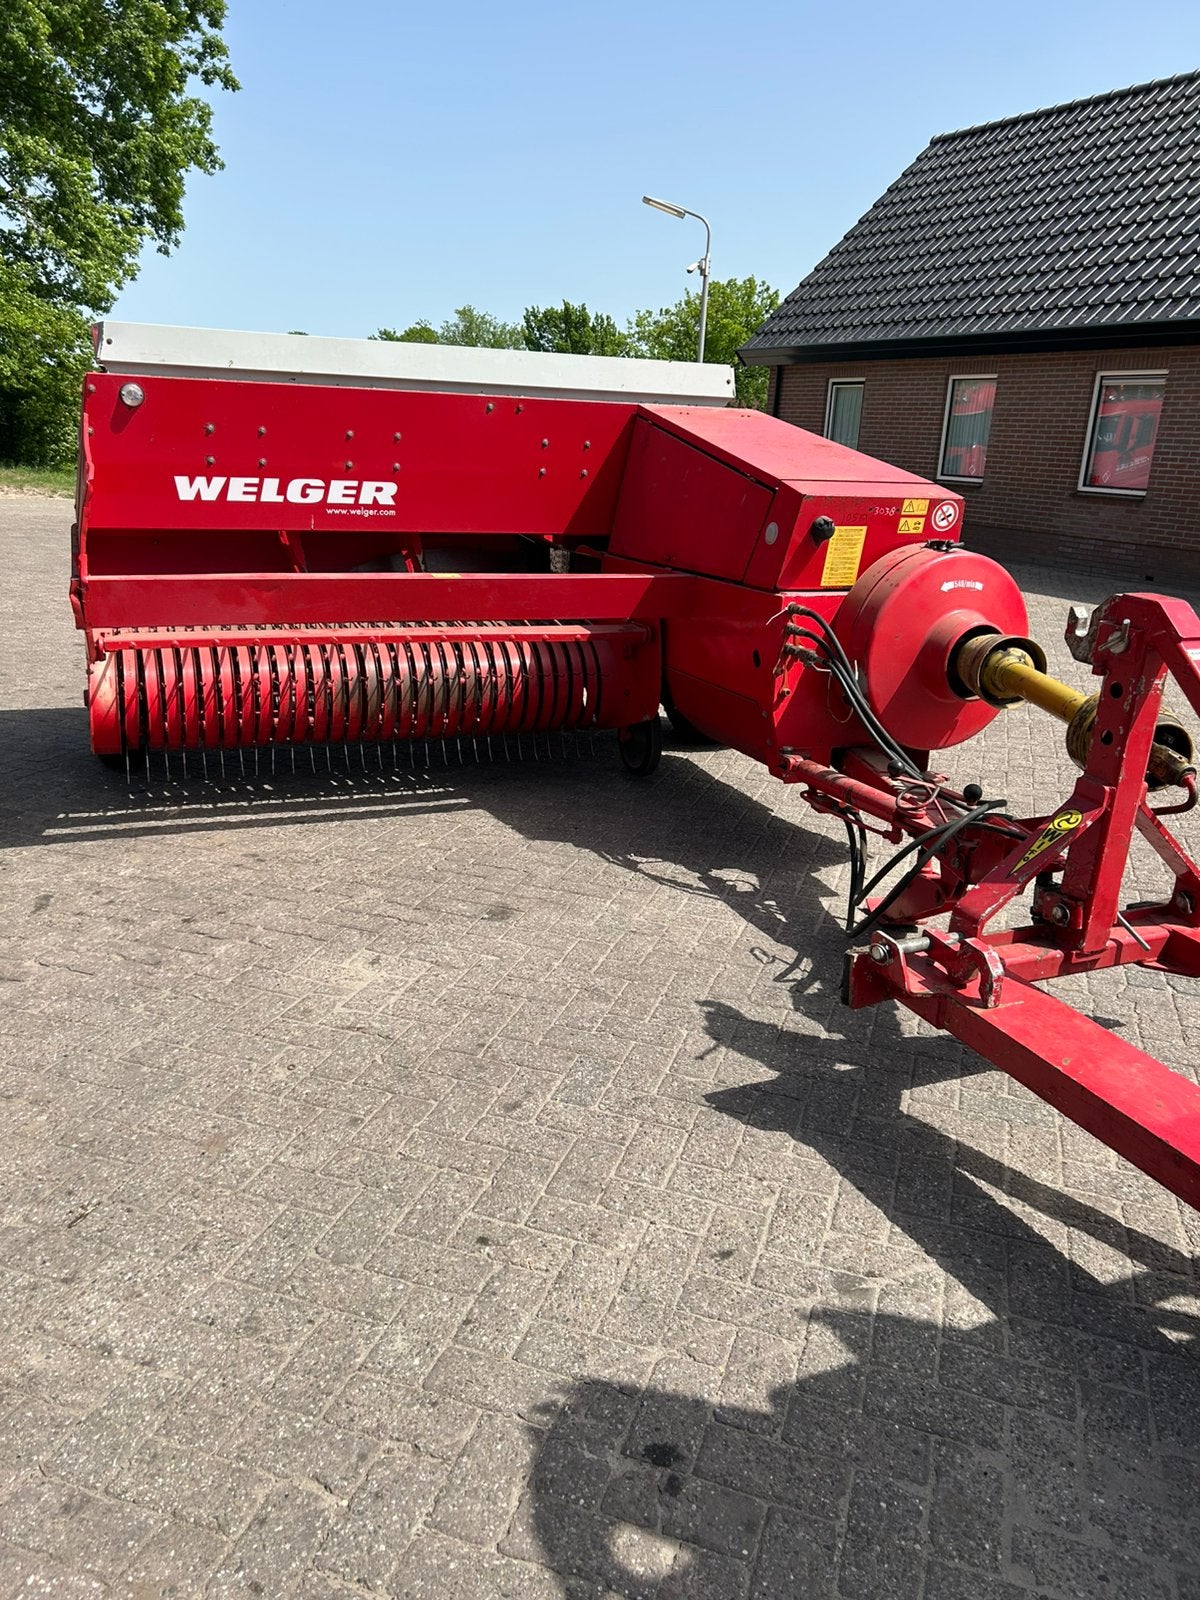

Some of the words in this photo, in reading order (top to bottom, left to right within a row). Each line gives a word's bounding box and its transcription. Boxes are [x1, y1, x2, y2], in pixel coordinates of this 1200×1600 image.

[174, 475, 398, 505] WELGER
[325, 507, 396, 518] www.welger.com
[873, 506, 896, 517] 3038
